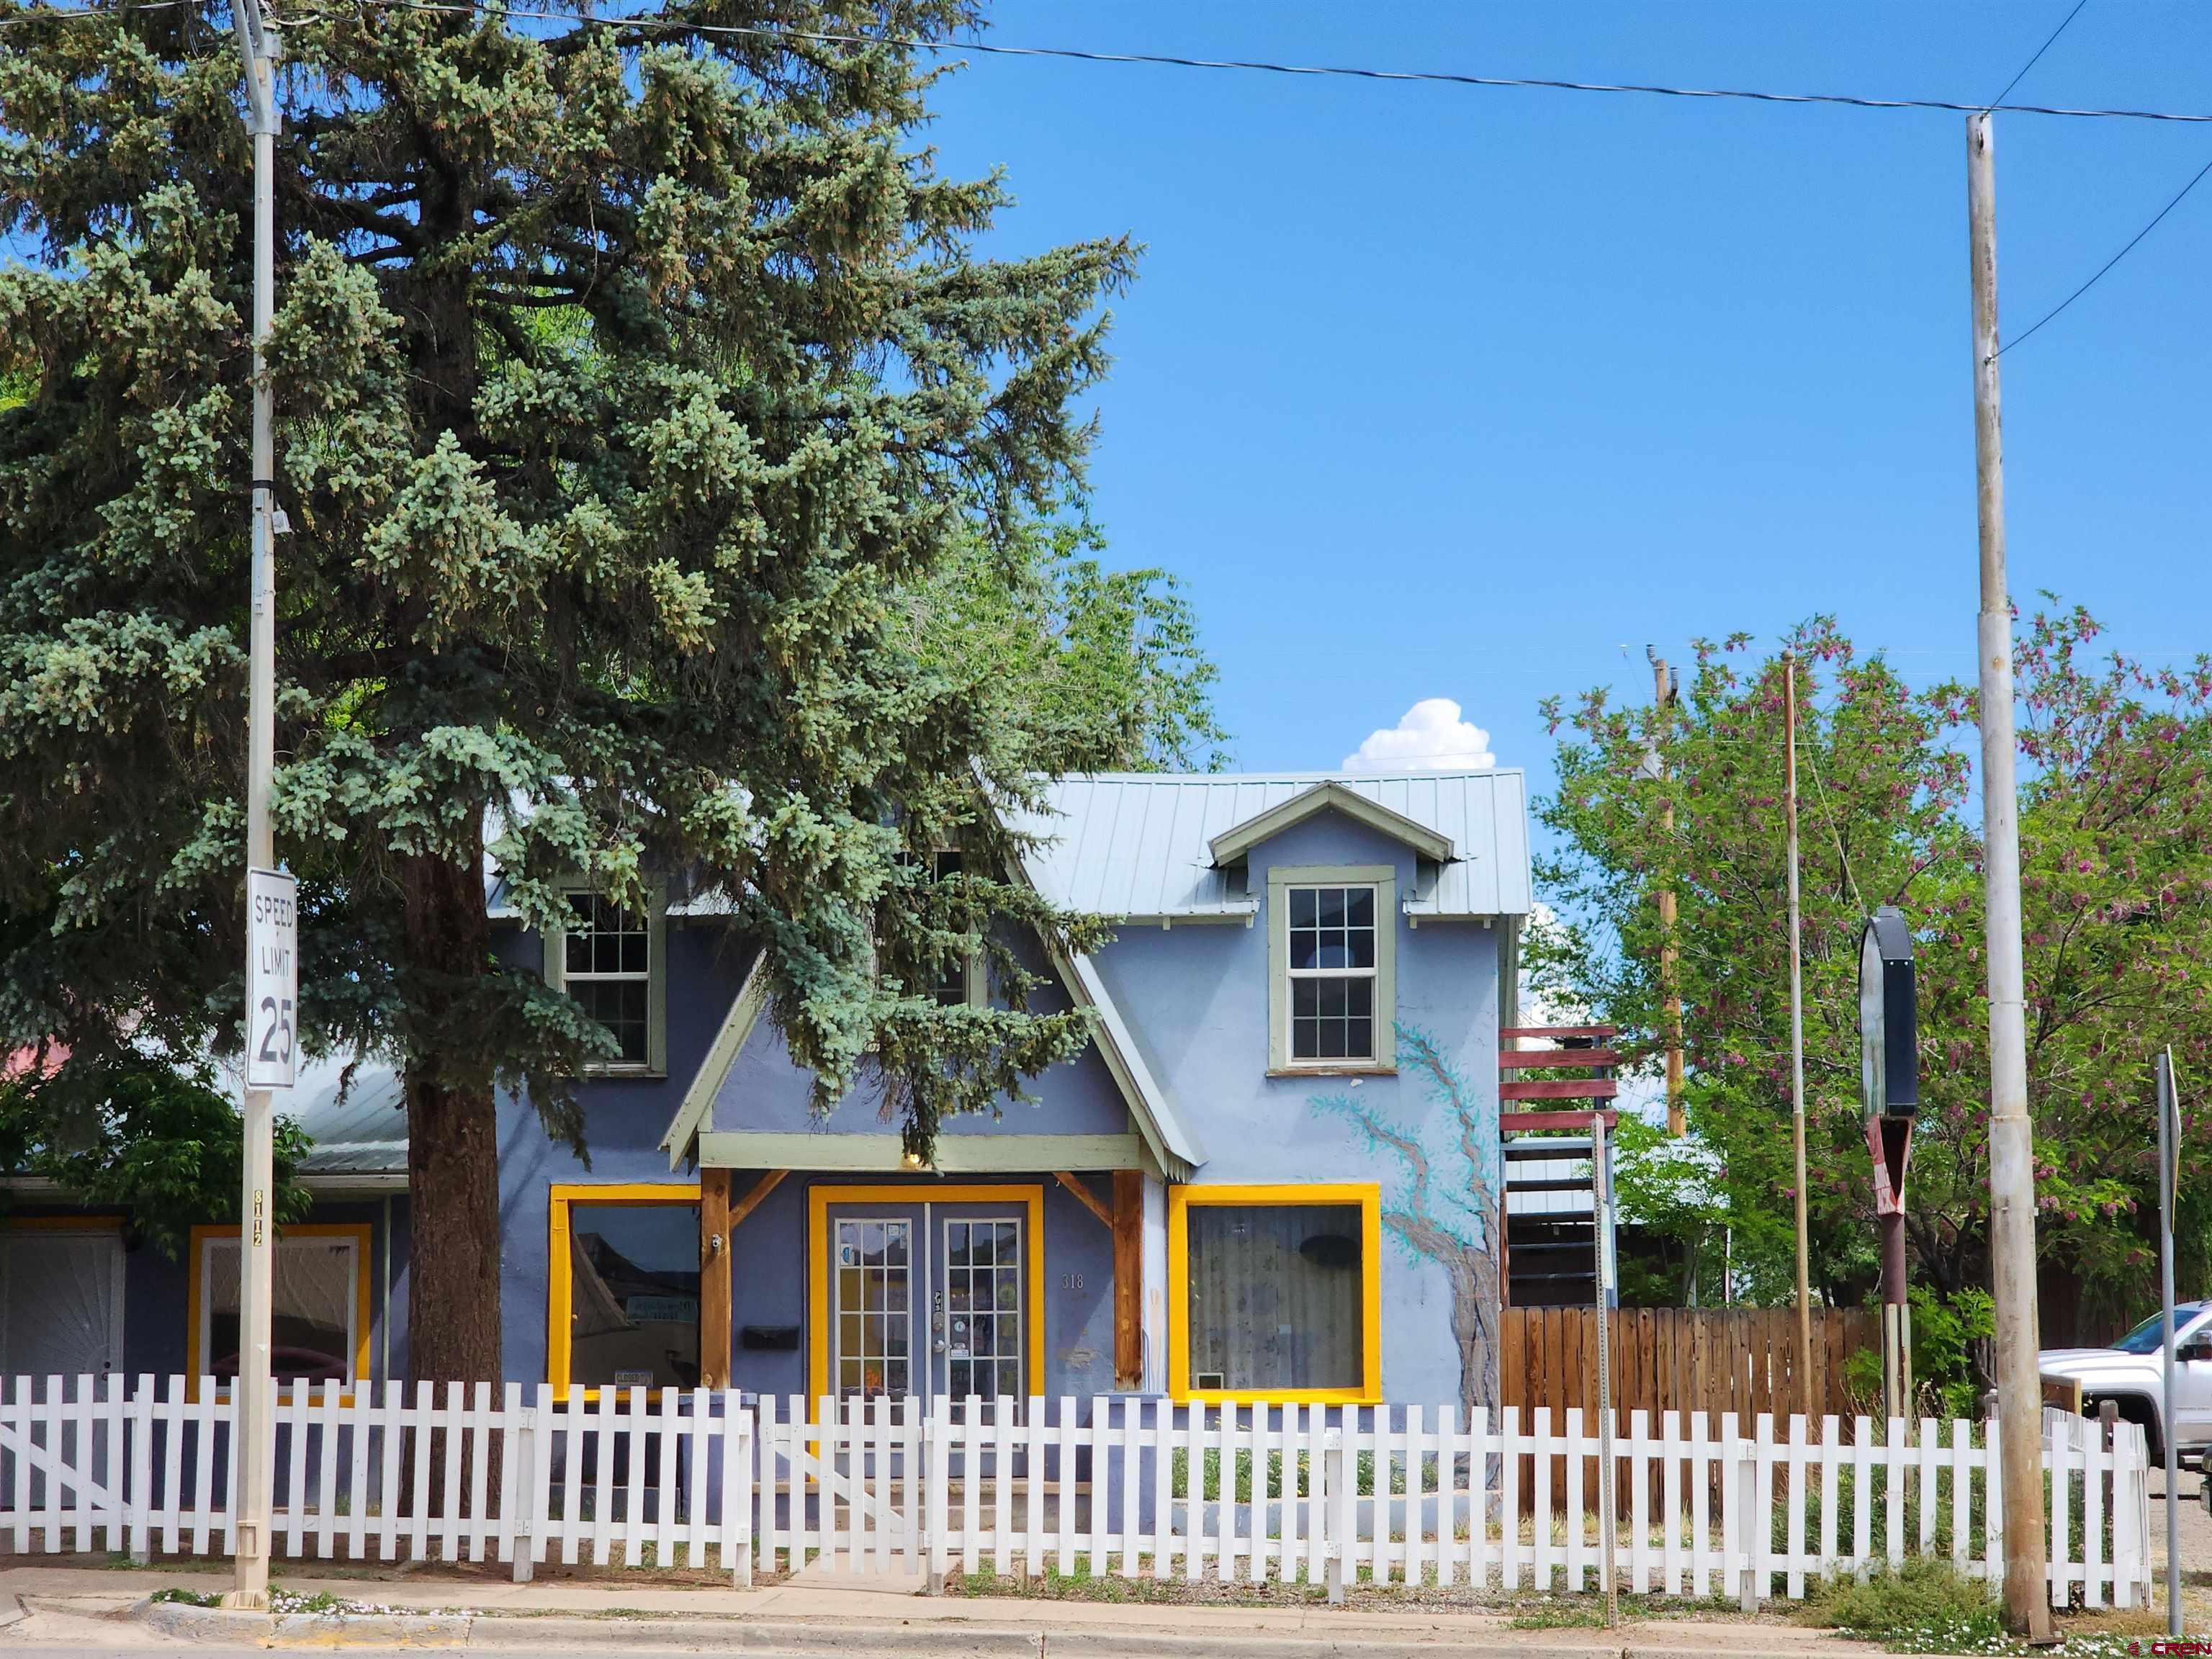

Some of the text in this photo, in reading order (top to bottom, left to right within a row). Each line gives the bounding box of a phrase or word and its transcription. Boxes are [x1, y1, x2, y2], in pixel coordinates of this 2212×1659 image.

[255, 894, 293, 928] SPEED
[261, 945, 290, 977] LIMIT
[259, 996, 292, 1064] 25
[1062, 1273, 1083, 1290] 318
